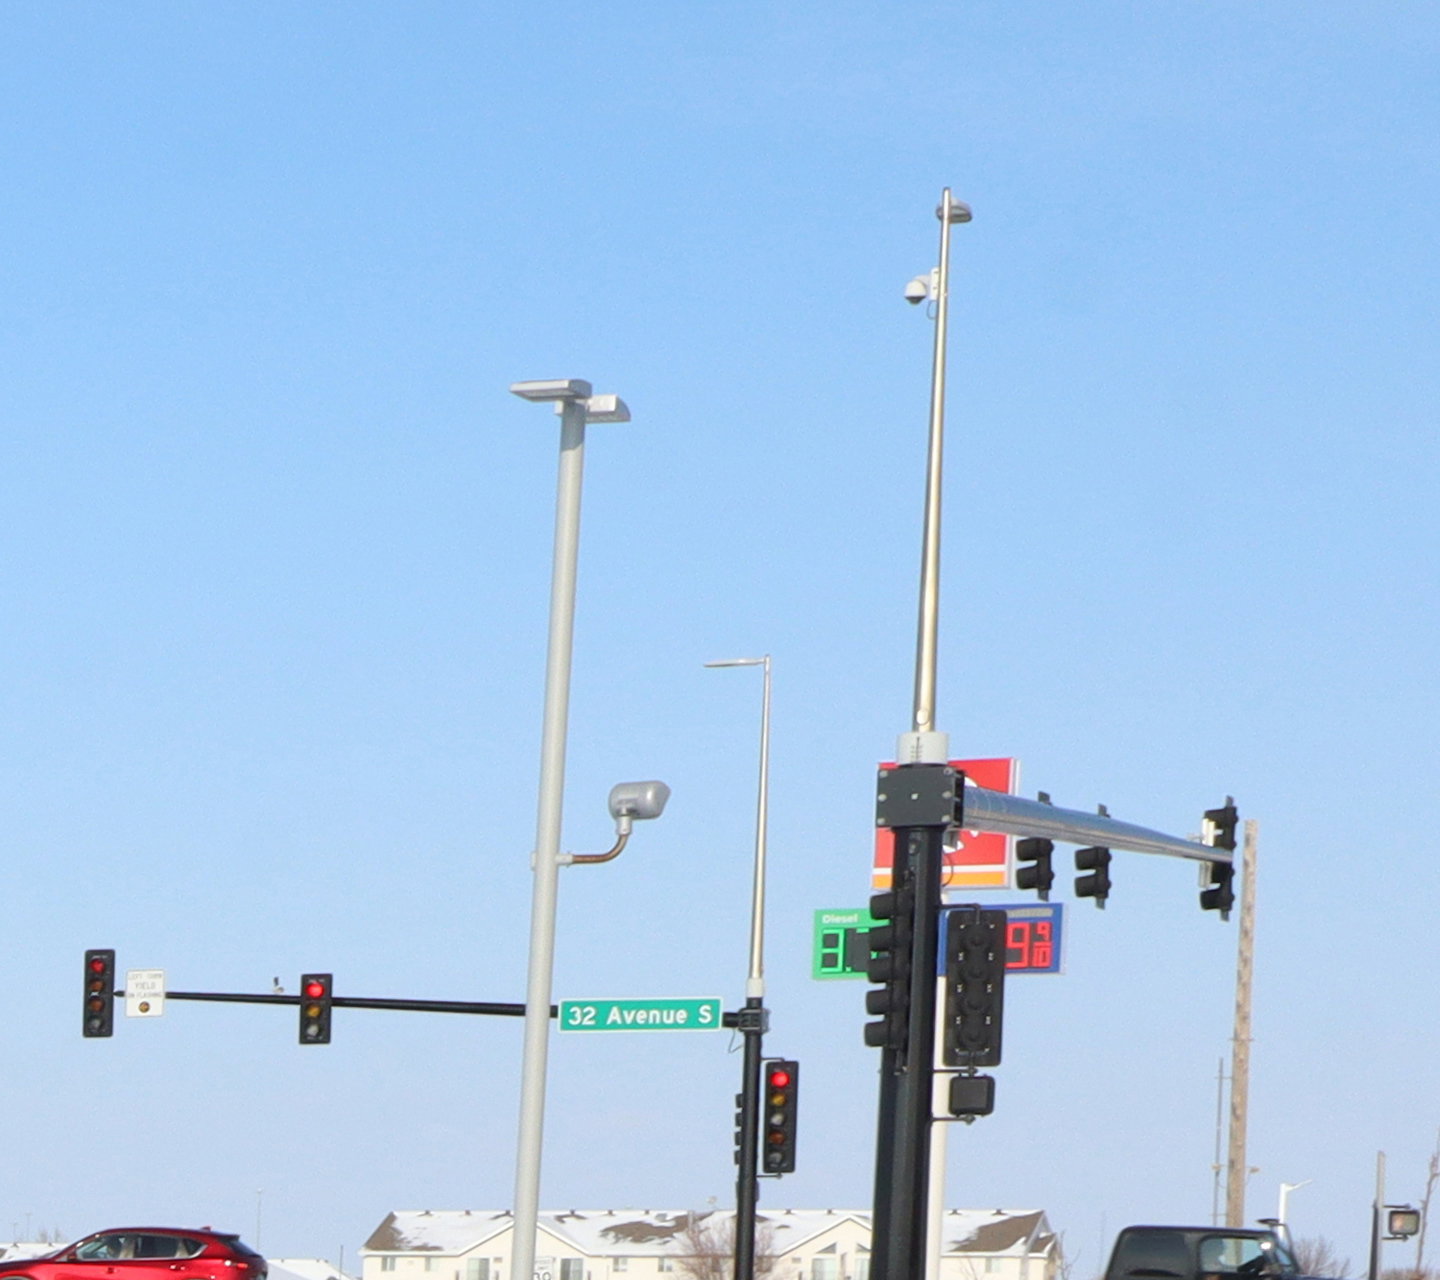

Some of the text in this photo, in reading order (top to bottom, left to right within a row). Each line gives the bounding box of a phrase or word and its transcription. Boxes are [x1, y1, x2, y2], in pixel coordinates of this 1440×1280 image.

[822, 913, 859, 924] Diesel
[568, 1004, 712, 1025] 32 Avenue S
